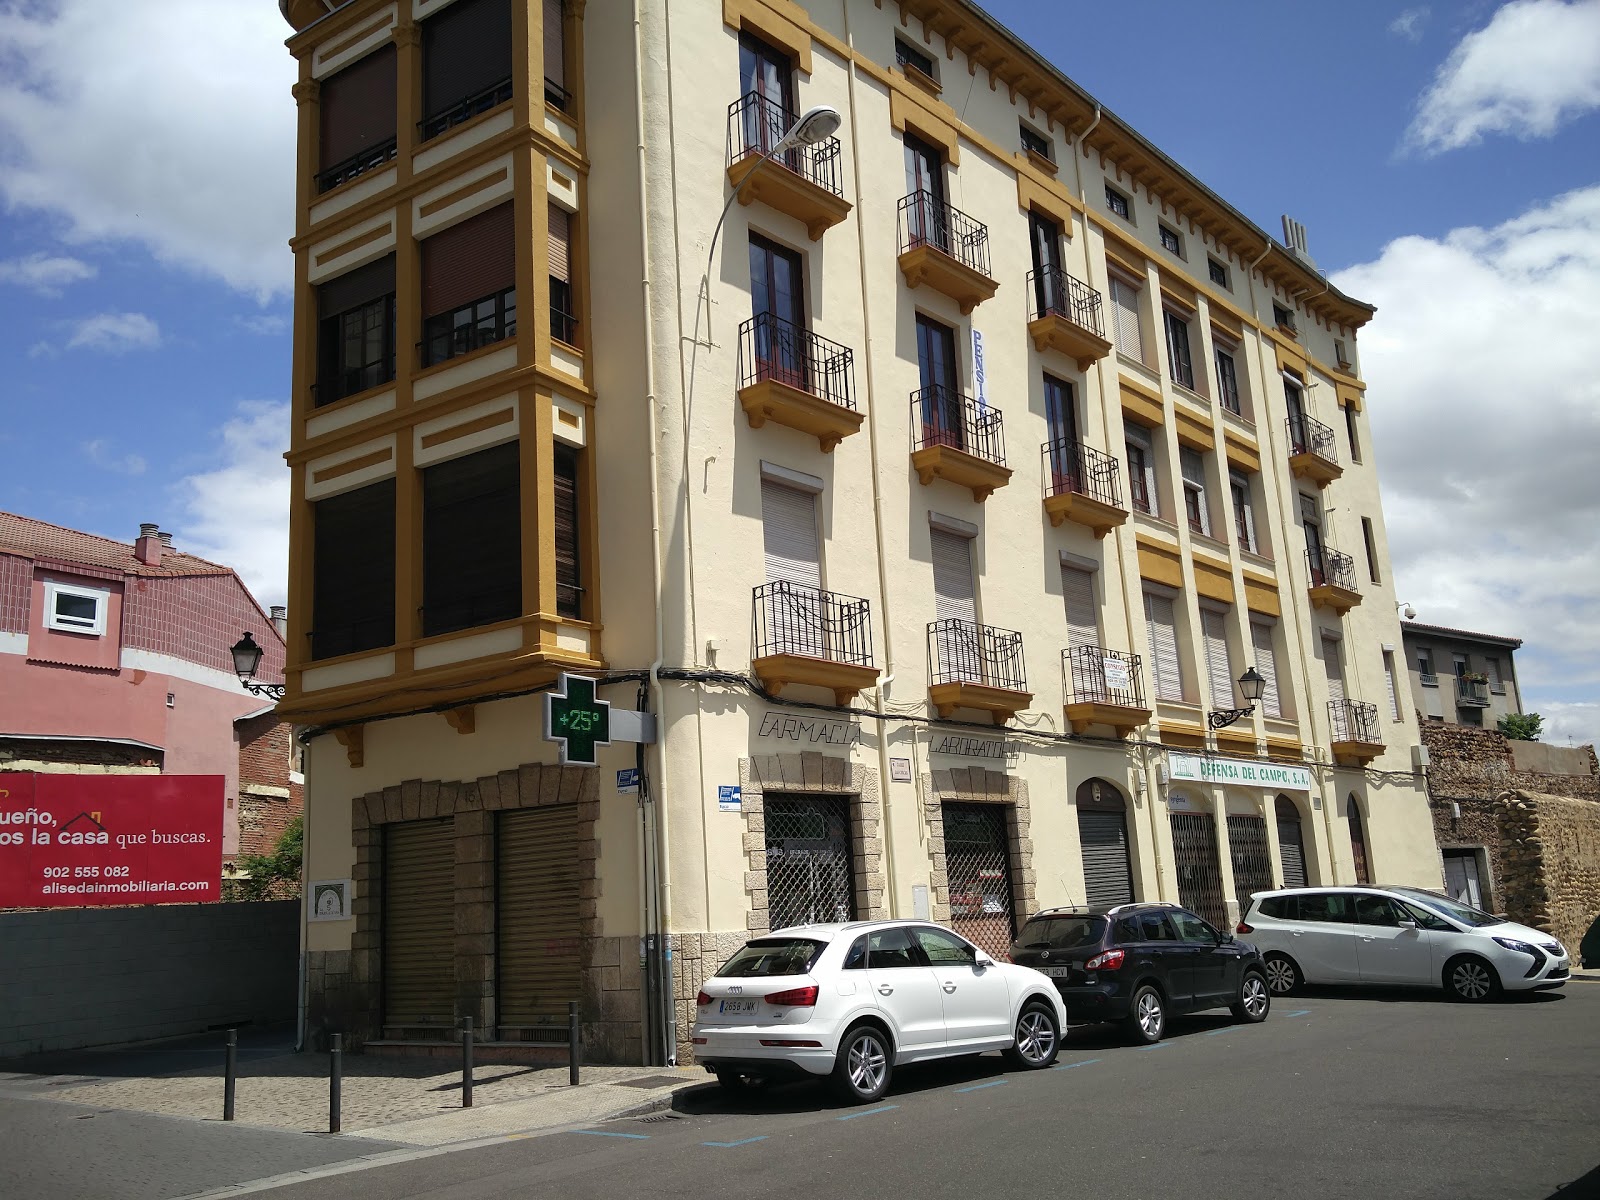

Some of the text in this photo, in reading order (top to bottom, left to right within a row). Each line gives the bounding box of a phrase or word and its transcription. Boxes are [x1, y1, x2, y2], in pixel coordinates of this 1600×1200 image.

[759, 712, 862, 745] FARMACIA
[1200, 761, 1239, 779] DEFENSA
[1241, 766, 1257, 780] DEL
[32, 828, 50, 845] la
[57, 831, 109, 845] casa
[116, 833, 147, 850] que
[151, 829, 212, 845] buscas.
[43, 866, 130, 879] 902 555 082
[42, 880, 209, 894] alisedainmobiliaria.com
